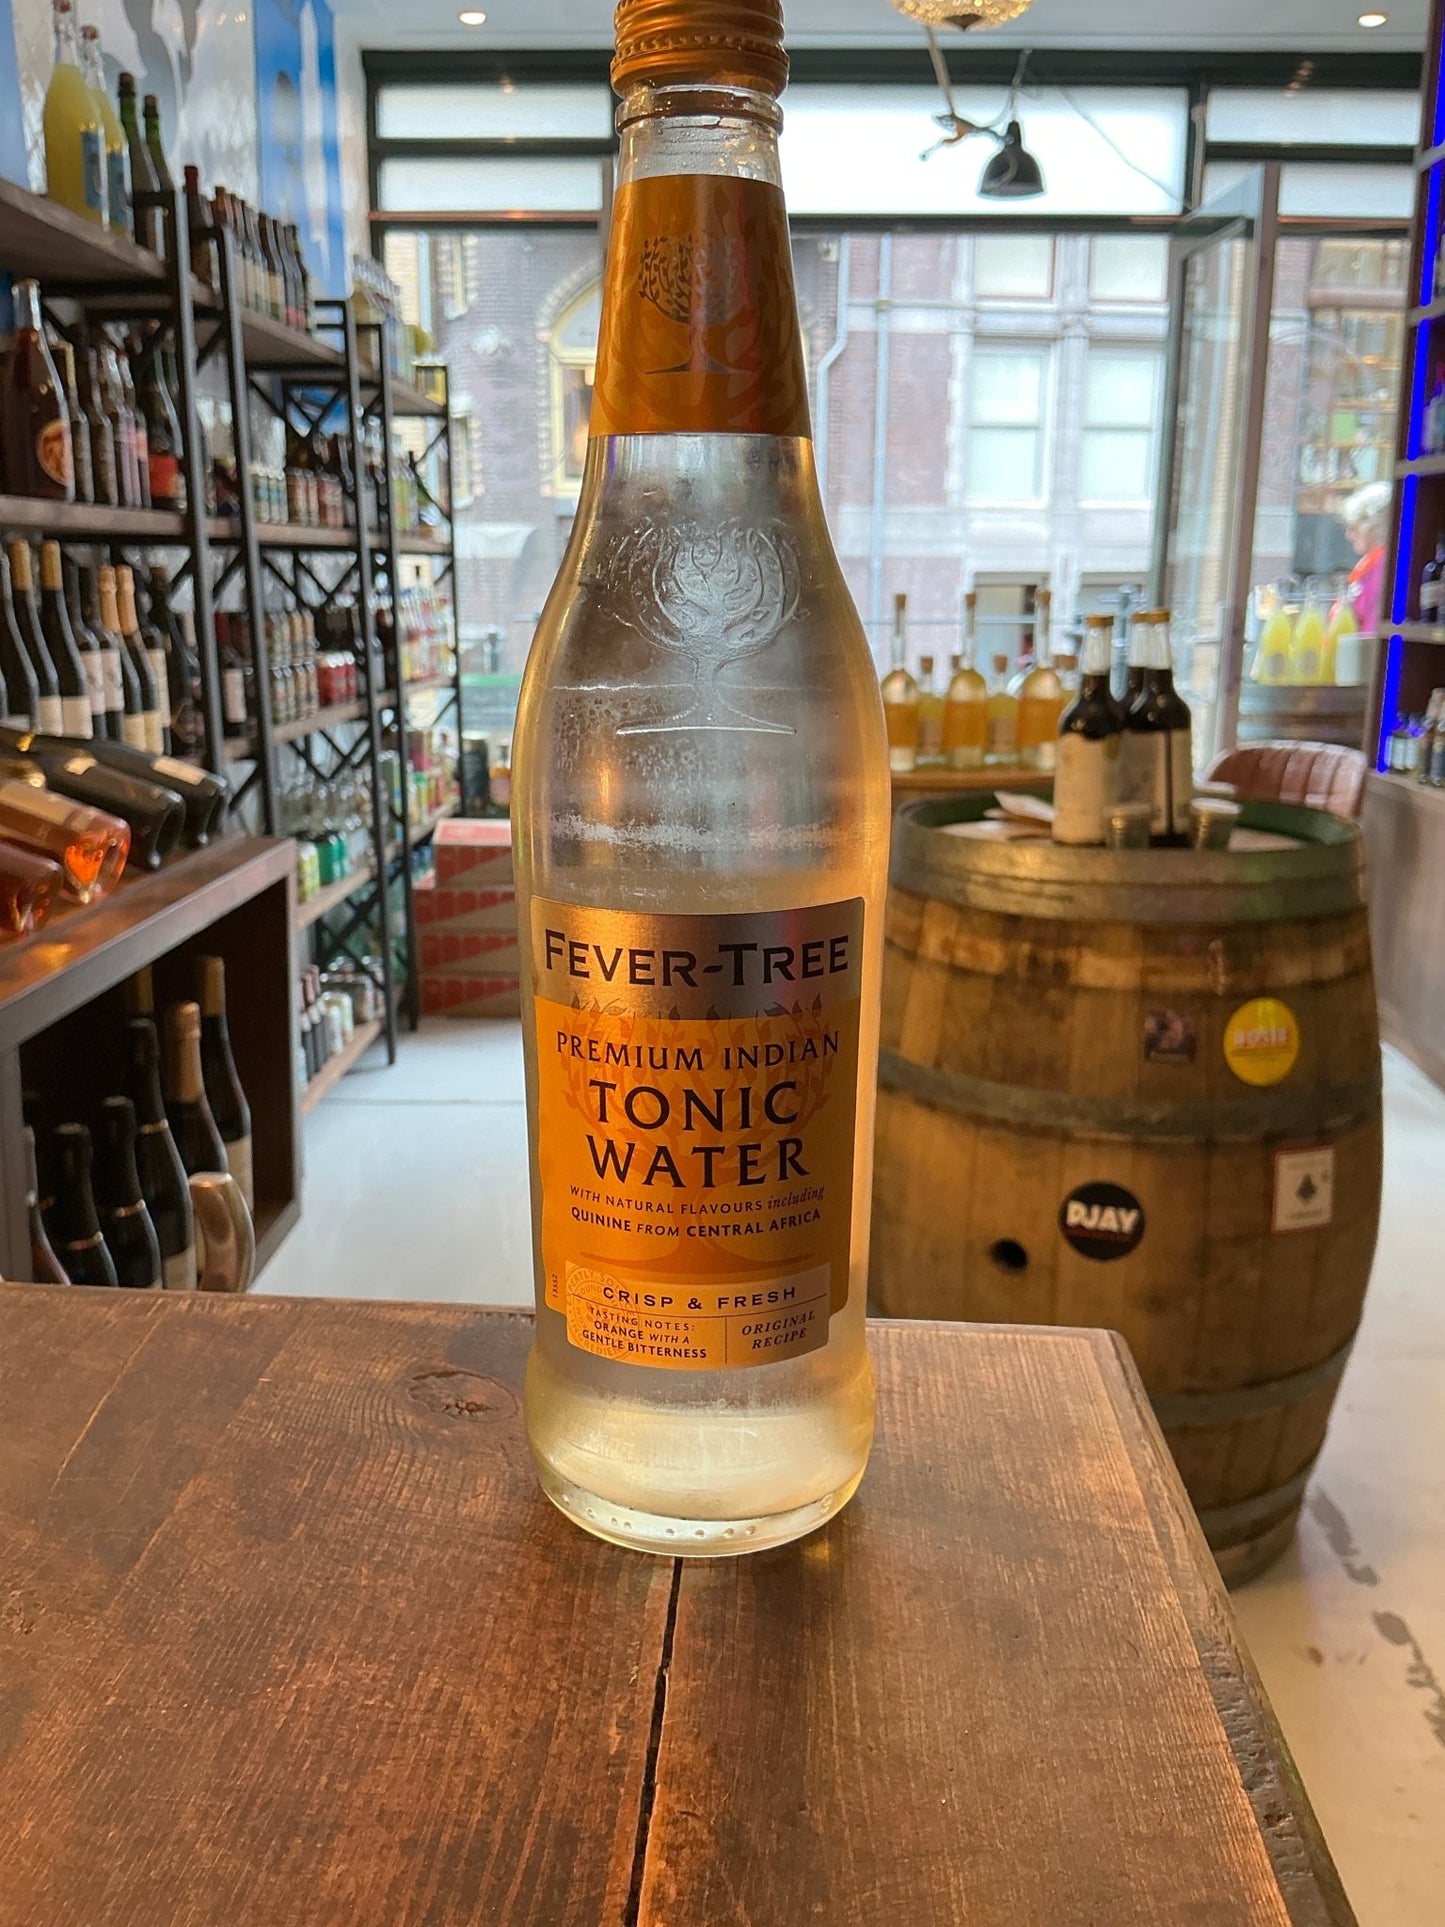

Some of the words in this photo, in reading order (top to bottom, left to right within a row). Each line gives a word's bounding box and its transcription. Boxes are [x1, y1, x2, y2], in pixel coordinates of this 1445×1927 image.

[545, 928, 849, 988] FEVER-TREE
[557, 1030, 704, 1071] PREMIUM
[723, 1030, 840, 1070] INDIAN
[589, 1078, 798, 1133] TONIC
[585, 1133, 810, 1188] WATER
[570, 1184, 600, 1203] WITH
[605, 1194, 674, 1215] NATURAL
[680, 1199, 762, 1215] FLAVOURS
[767, 1185, 824, 1211] including
[571, 1206, 632, 1233] QUININE
[636, 1222, 680, 1237] FROM
[686, 1223, 764, 1238] CENTRAL
[768, 1208, 821, 1232] AFRICA
[603, 1286, 674, 1308] CRISP
[687, 1297, 702, 1310] &
[718, 1286, 796, 1310] FRESH
[590, 1306, 639, 1326] TASTING
[644, 1319, 695, 1332] NOTES:
[594, 1319, 645, 1341] ORANGE
[649, 1332, 678, 1344] WITH
[682, 1335, 690, 1345] A
[741, 1310, 816, 1336] ORIGINAL
[582, 1328, 624, 1350] GENTLE
[627, 1341, 707, 1359] BITTERNESS
[751, 1327, 807, 1350] RECIPE
